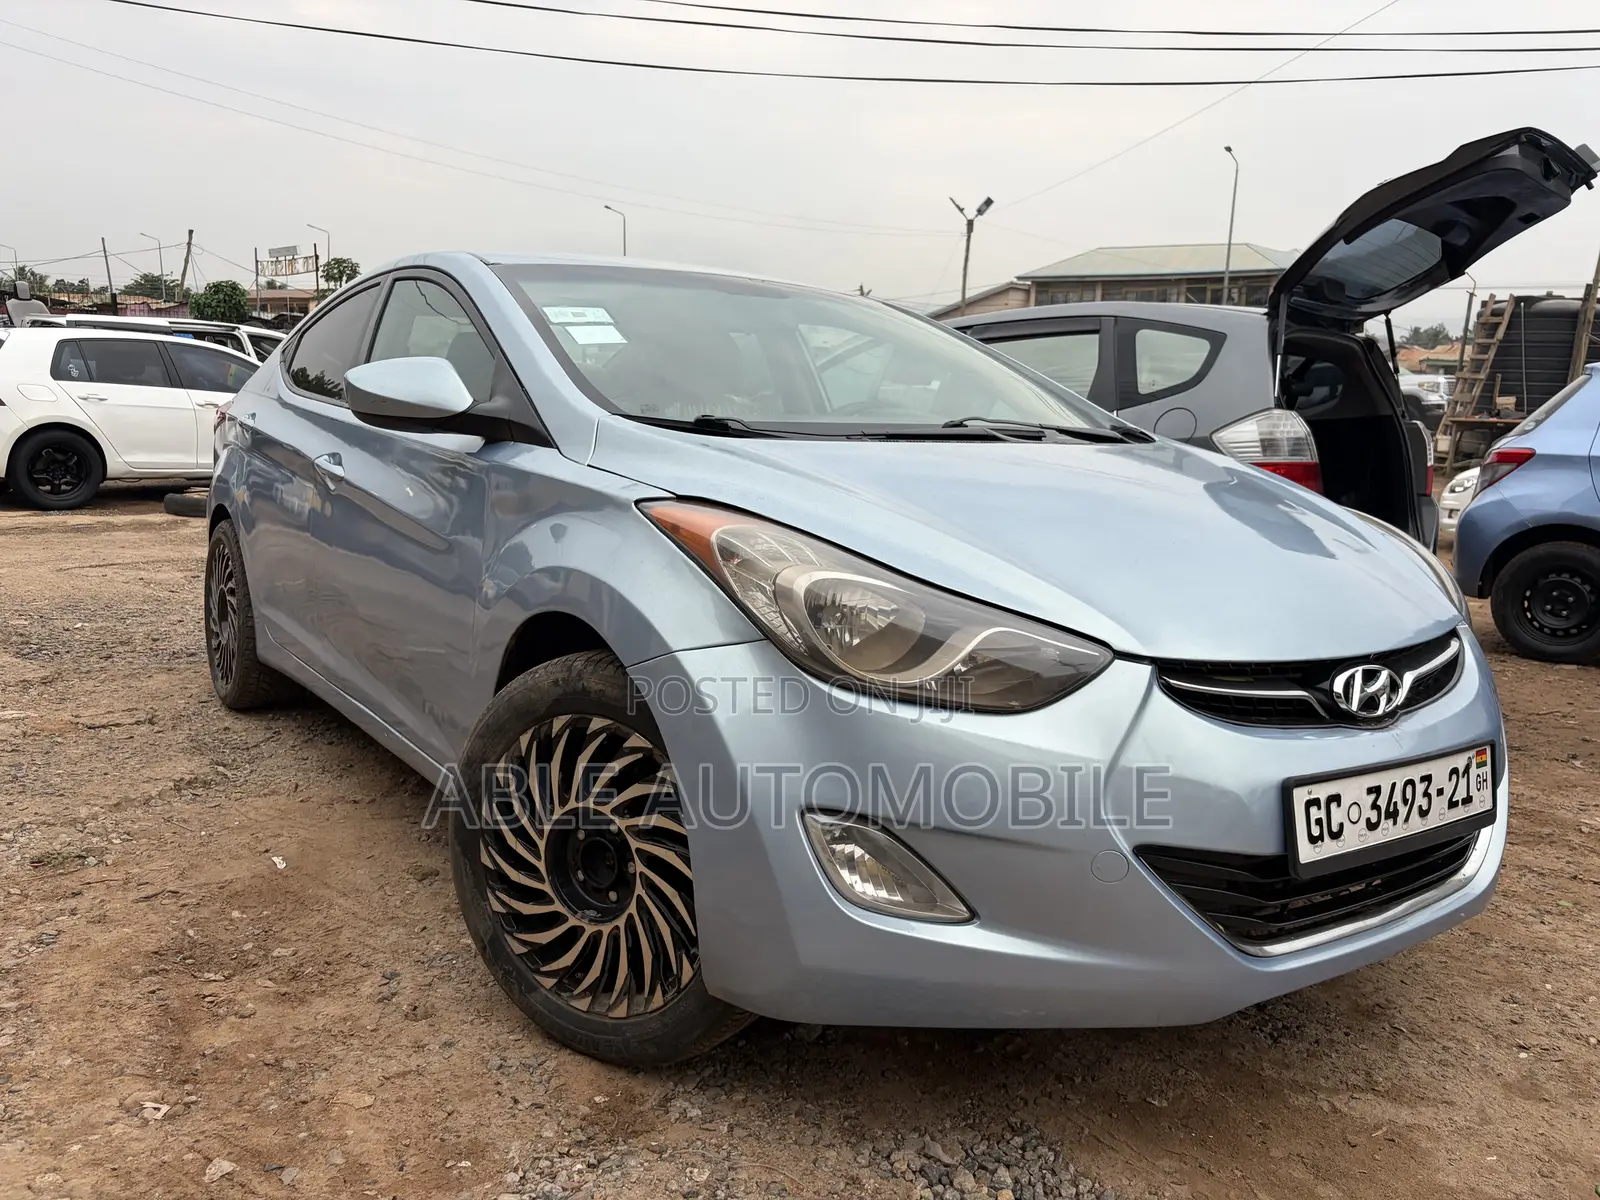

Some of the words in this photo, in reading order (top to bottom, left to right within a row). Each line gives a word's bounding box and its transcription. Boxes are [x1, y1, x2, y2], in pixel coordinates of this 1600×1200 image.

[1304, 793, 1344, 845] GC
[1365, 762, 1474, 832] 3493-21
[1475, 770, 1489, 793] GH
